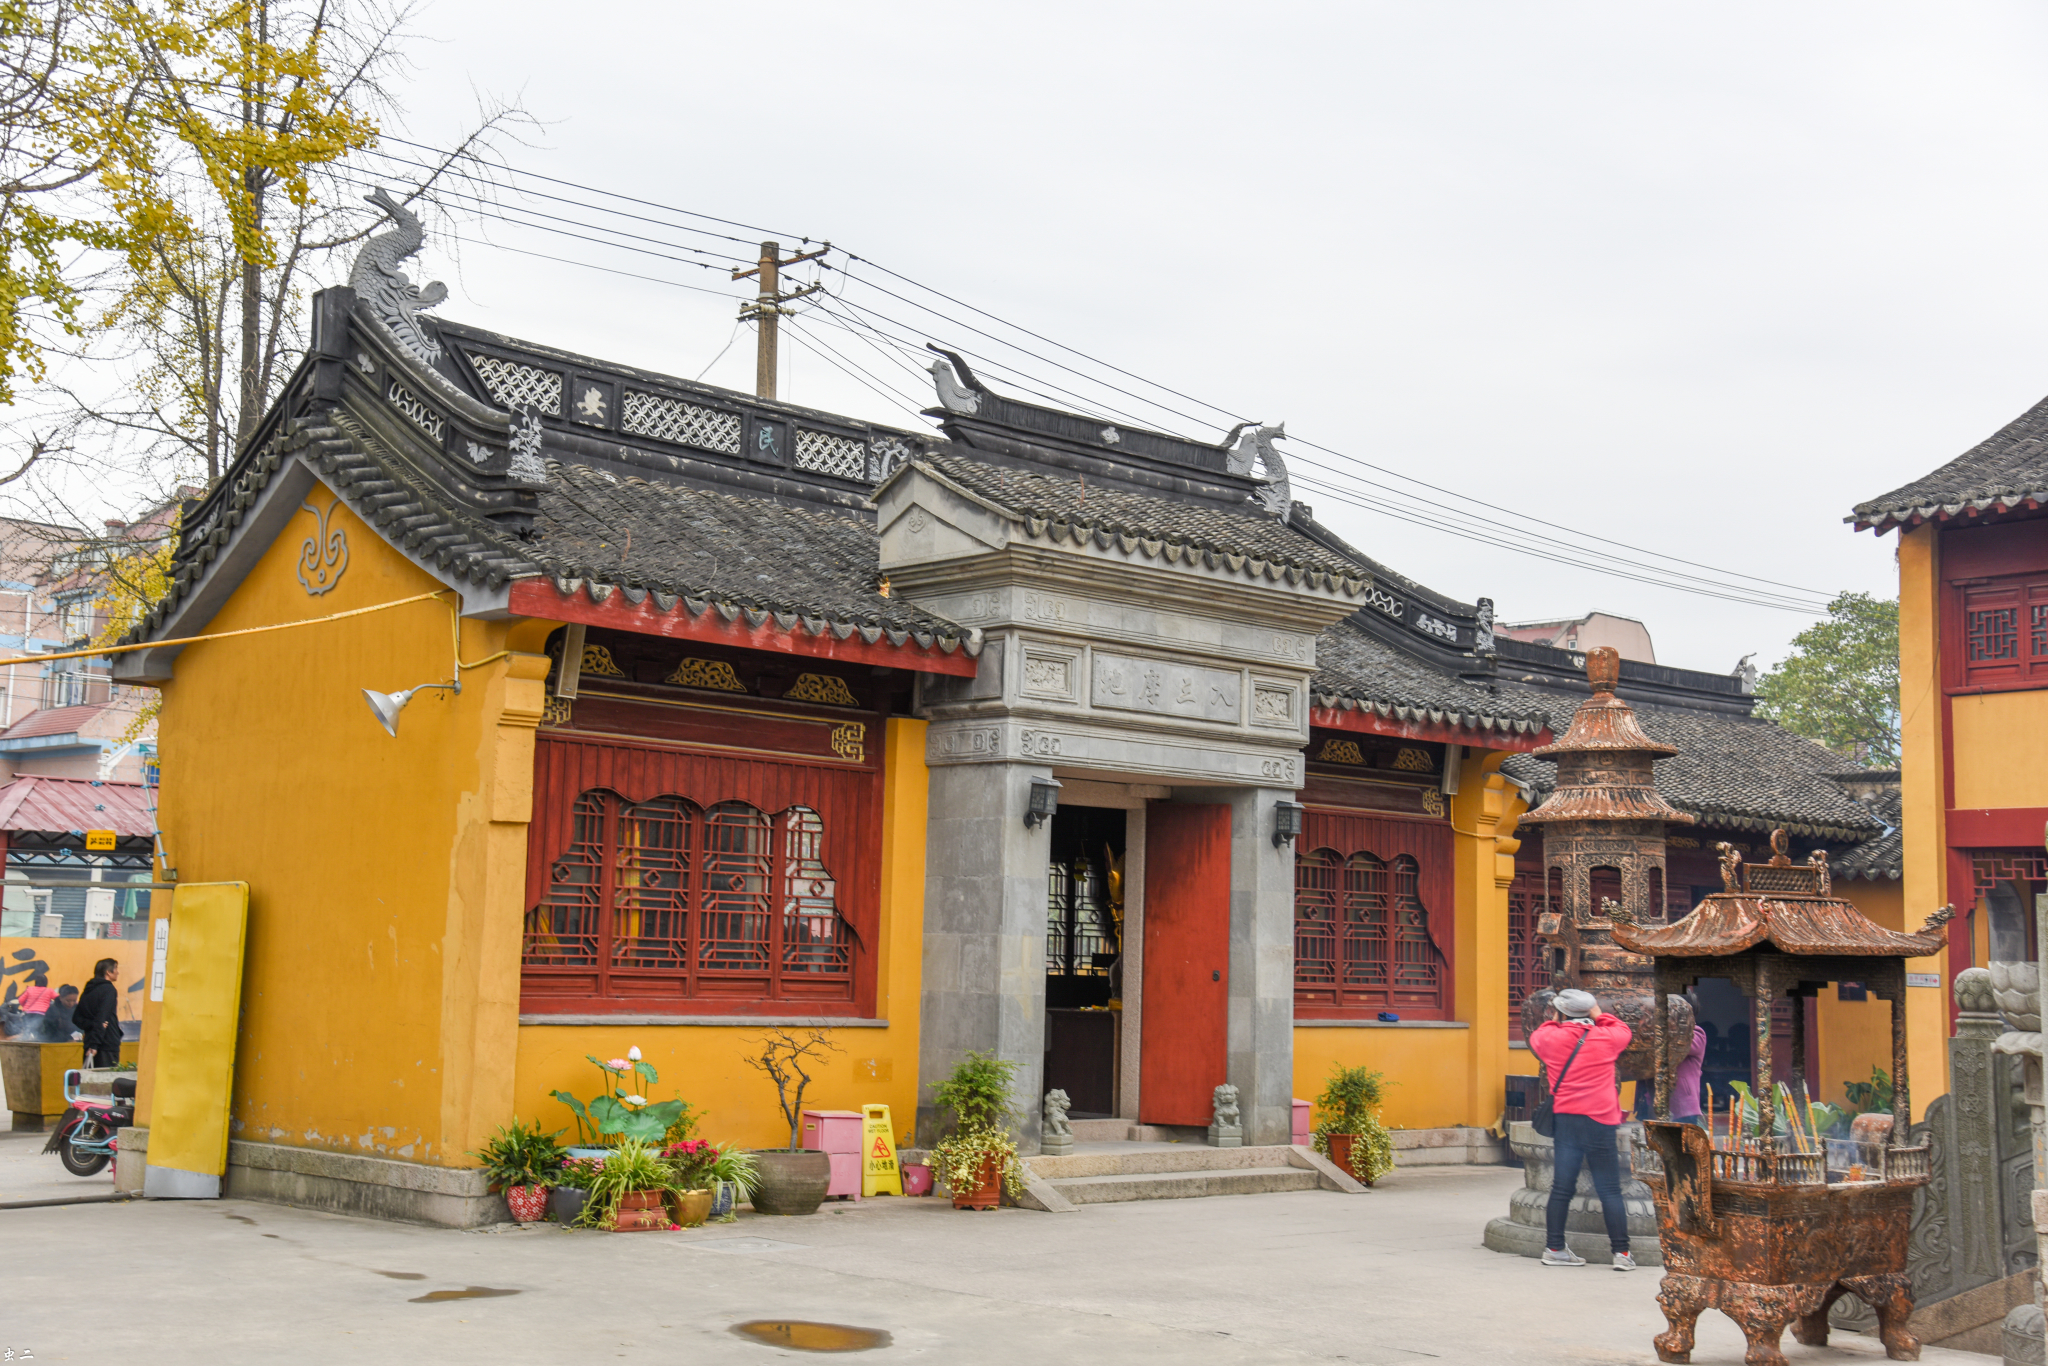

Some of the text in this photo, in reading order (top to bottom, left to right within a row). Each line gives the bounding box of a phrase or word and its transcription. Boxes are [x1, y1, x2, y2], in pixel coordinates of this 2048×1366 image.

[759, 426, 779, 458] 民
[107, 921, 122, 937] 美
[153, 927, 167, 990] 出口
[869, 1159, 895, 1171] 小心地滑
